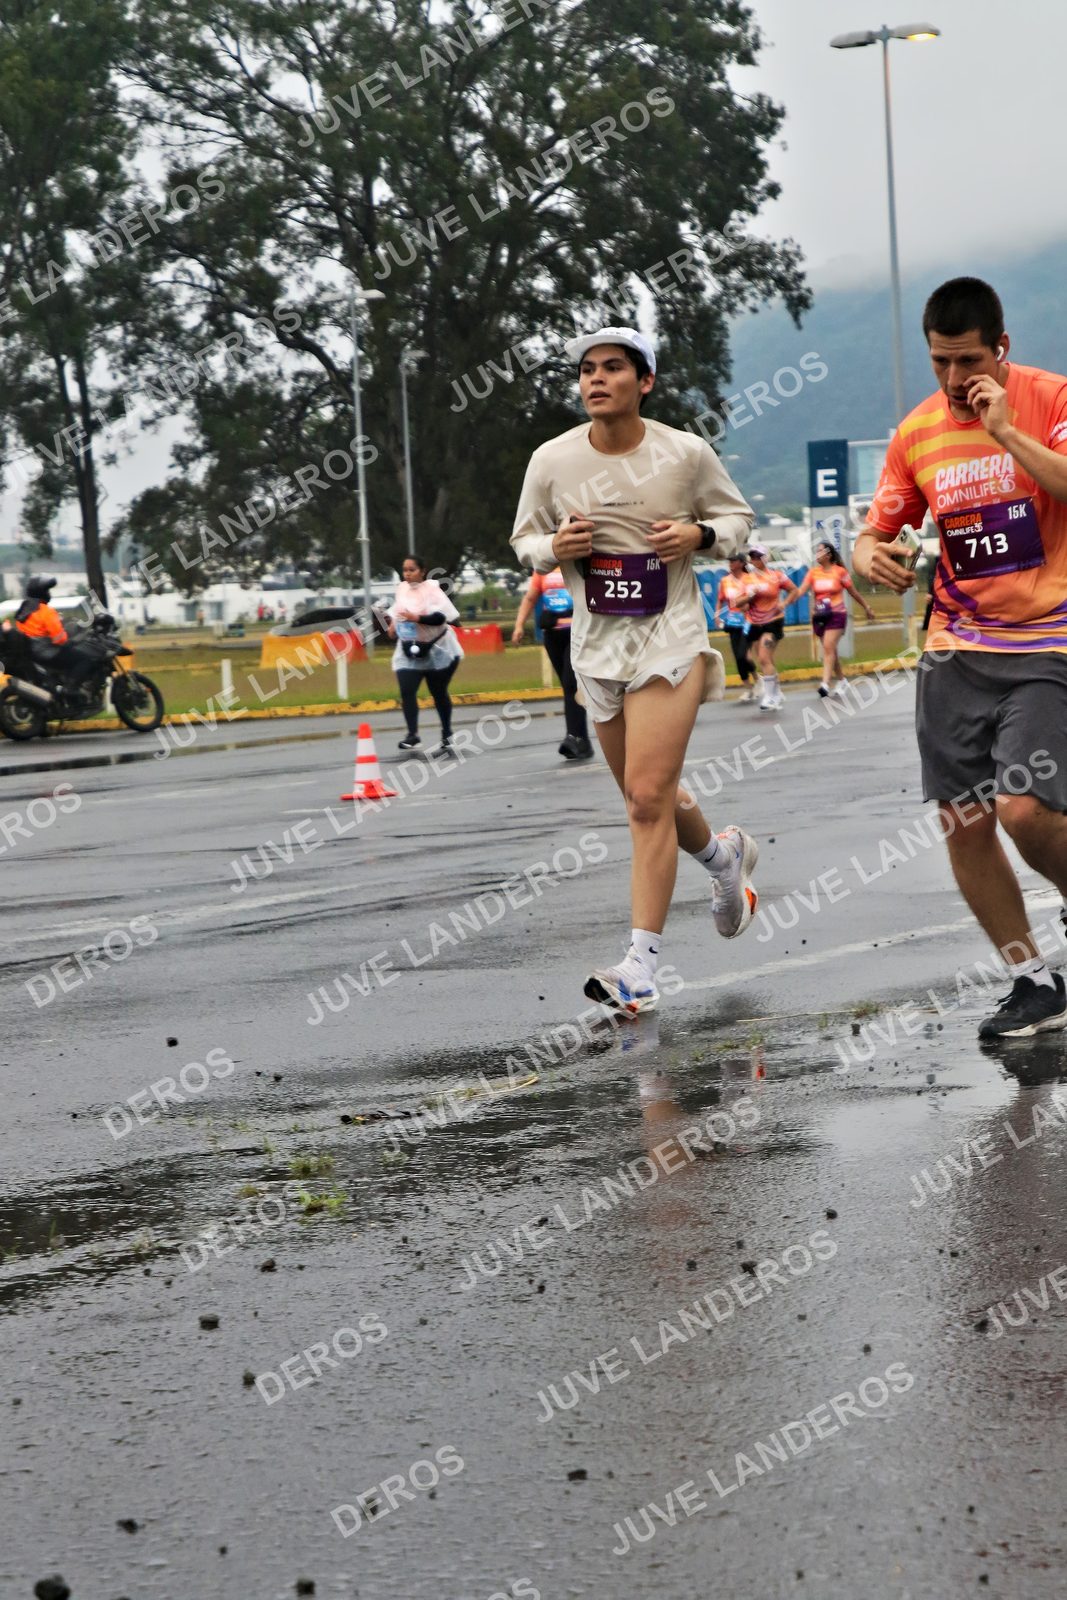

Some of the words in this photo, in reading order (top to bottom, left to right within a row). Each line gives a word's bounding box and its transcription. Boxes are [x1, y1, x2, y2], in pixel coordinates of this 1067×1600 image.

[935, 452, 1014, 492] CARRERA
[816, 468, 838, 498] E
[937, 481, 997, 508] OMNILIFE
[945, 513, 982, 529] CARRERA
[1008, 504, 1027, 520] 15K
[947, 527, 974, 537] OMNILIFE
[965, 533, 1008, 558] 713
[646, 558, 661, 571] 15K
[604, 580, 642, 598] 252
